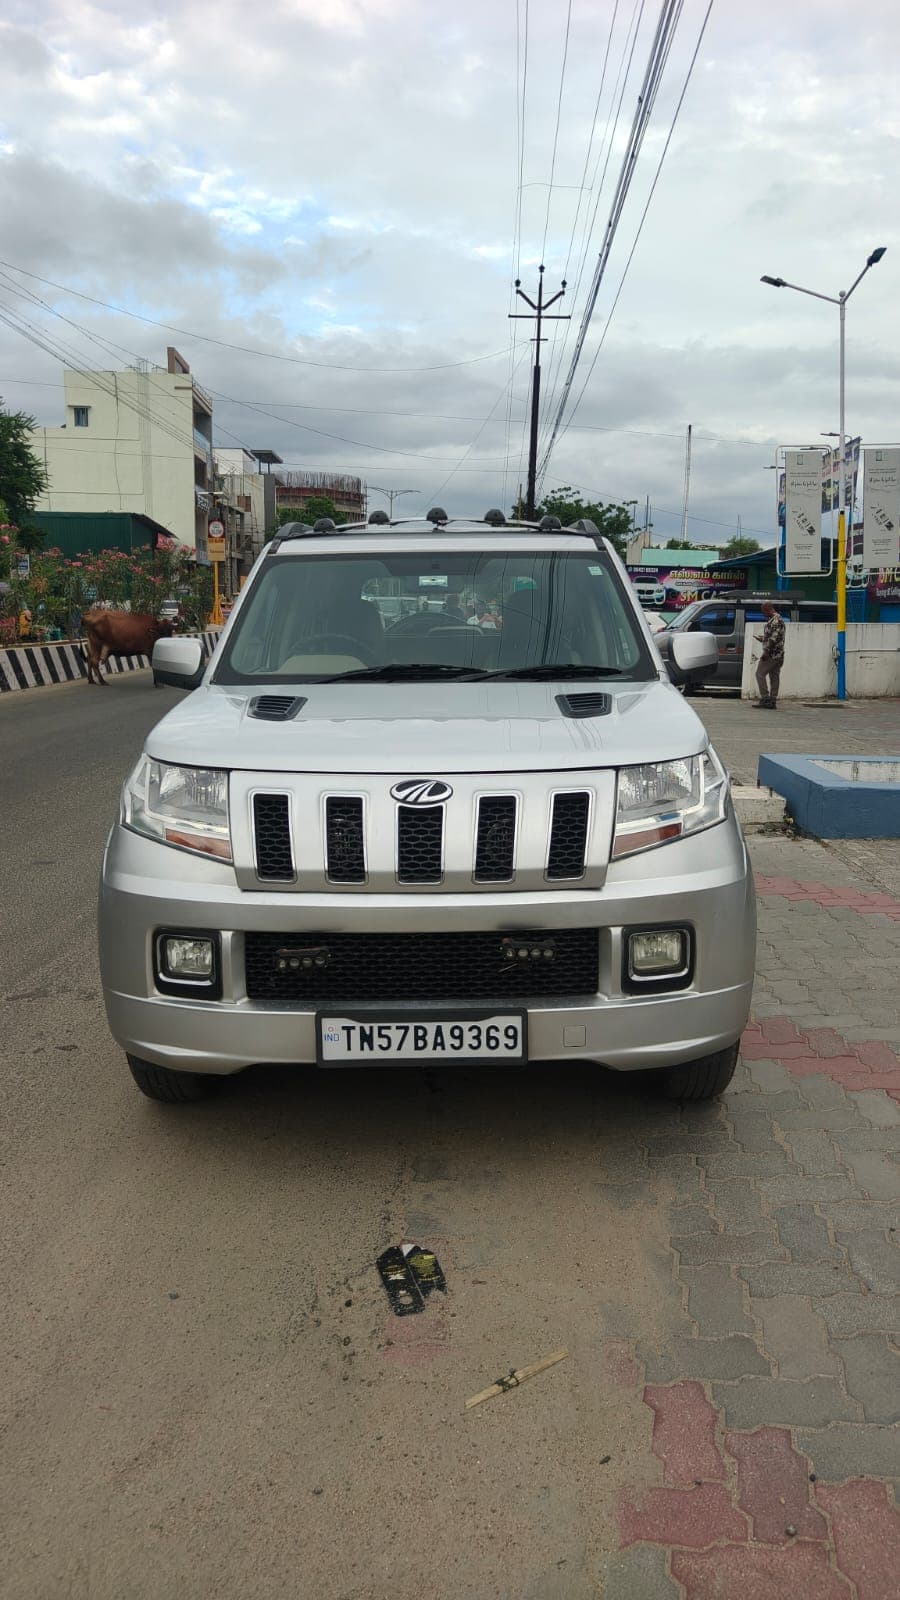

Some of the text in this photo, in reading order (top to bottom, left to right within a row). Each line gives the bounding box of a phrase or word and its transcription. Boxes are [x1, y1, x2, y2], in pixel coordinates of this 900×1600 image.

[680, 590, 698, 602] SM
[324, 1033, 340, 1042] IND
[341, 1024, 519, 1052] TN57BA9369
